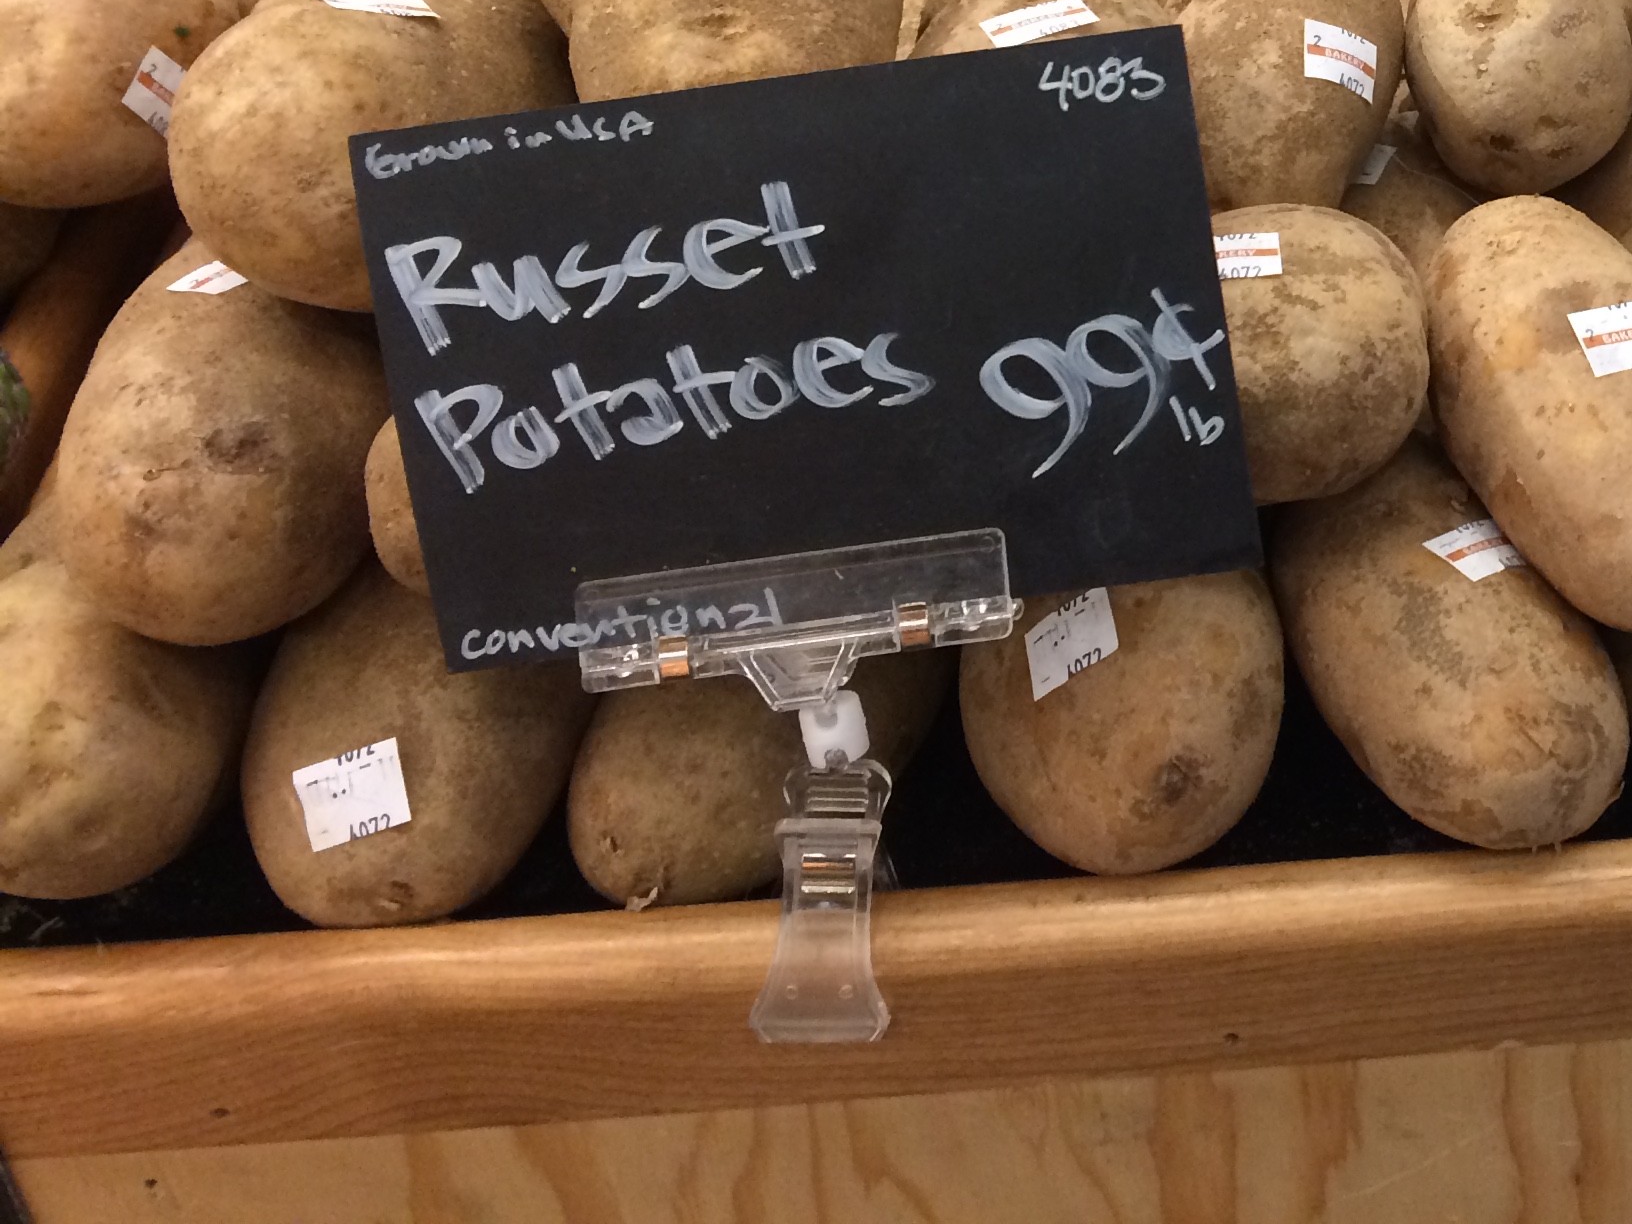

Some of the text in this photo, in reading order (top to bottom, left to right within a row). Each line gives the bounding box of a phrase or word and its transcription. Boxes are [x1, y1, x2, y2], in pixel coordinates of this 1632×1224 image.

[1037, 56, 1167, 112] 4083
[1324, 47, 1365, 71] BAKERY
[365, 136, 494, 180] Grown
[503, 126, 553, 150] in
[385, 180, 826, 357] Russet
[414, 332, 936, 495] Potatoes
[1170, 394, 1226, 447] lb
[460, 586, 780, 662] conventional
